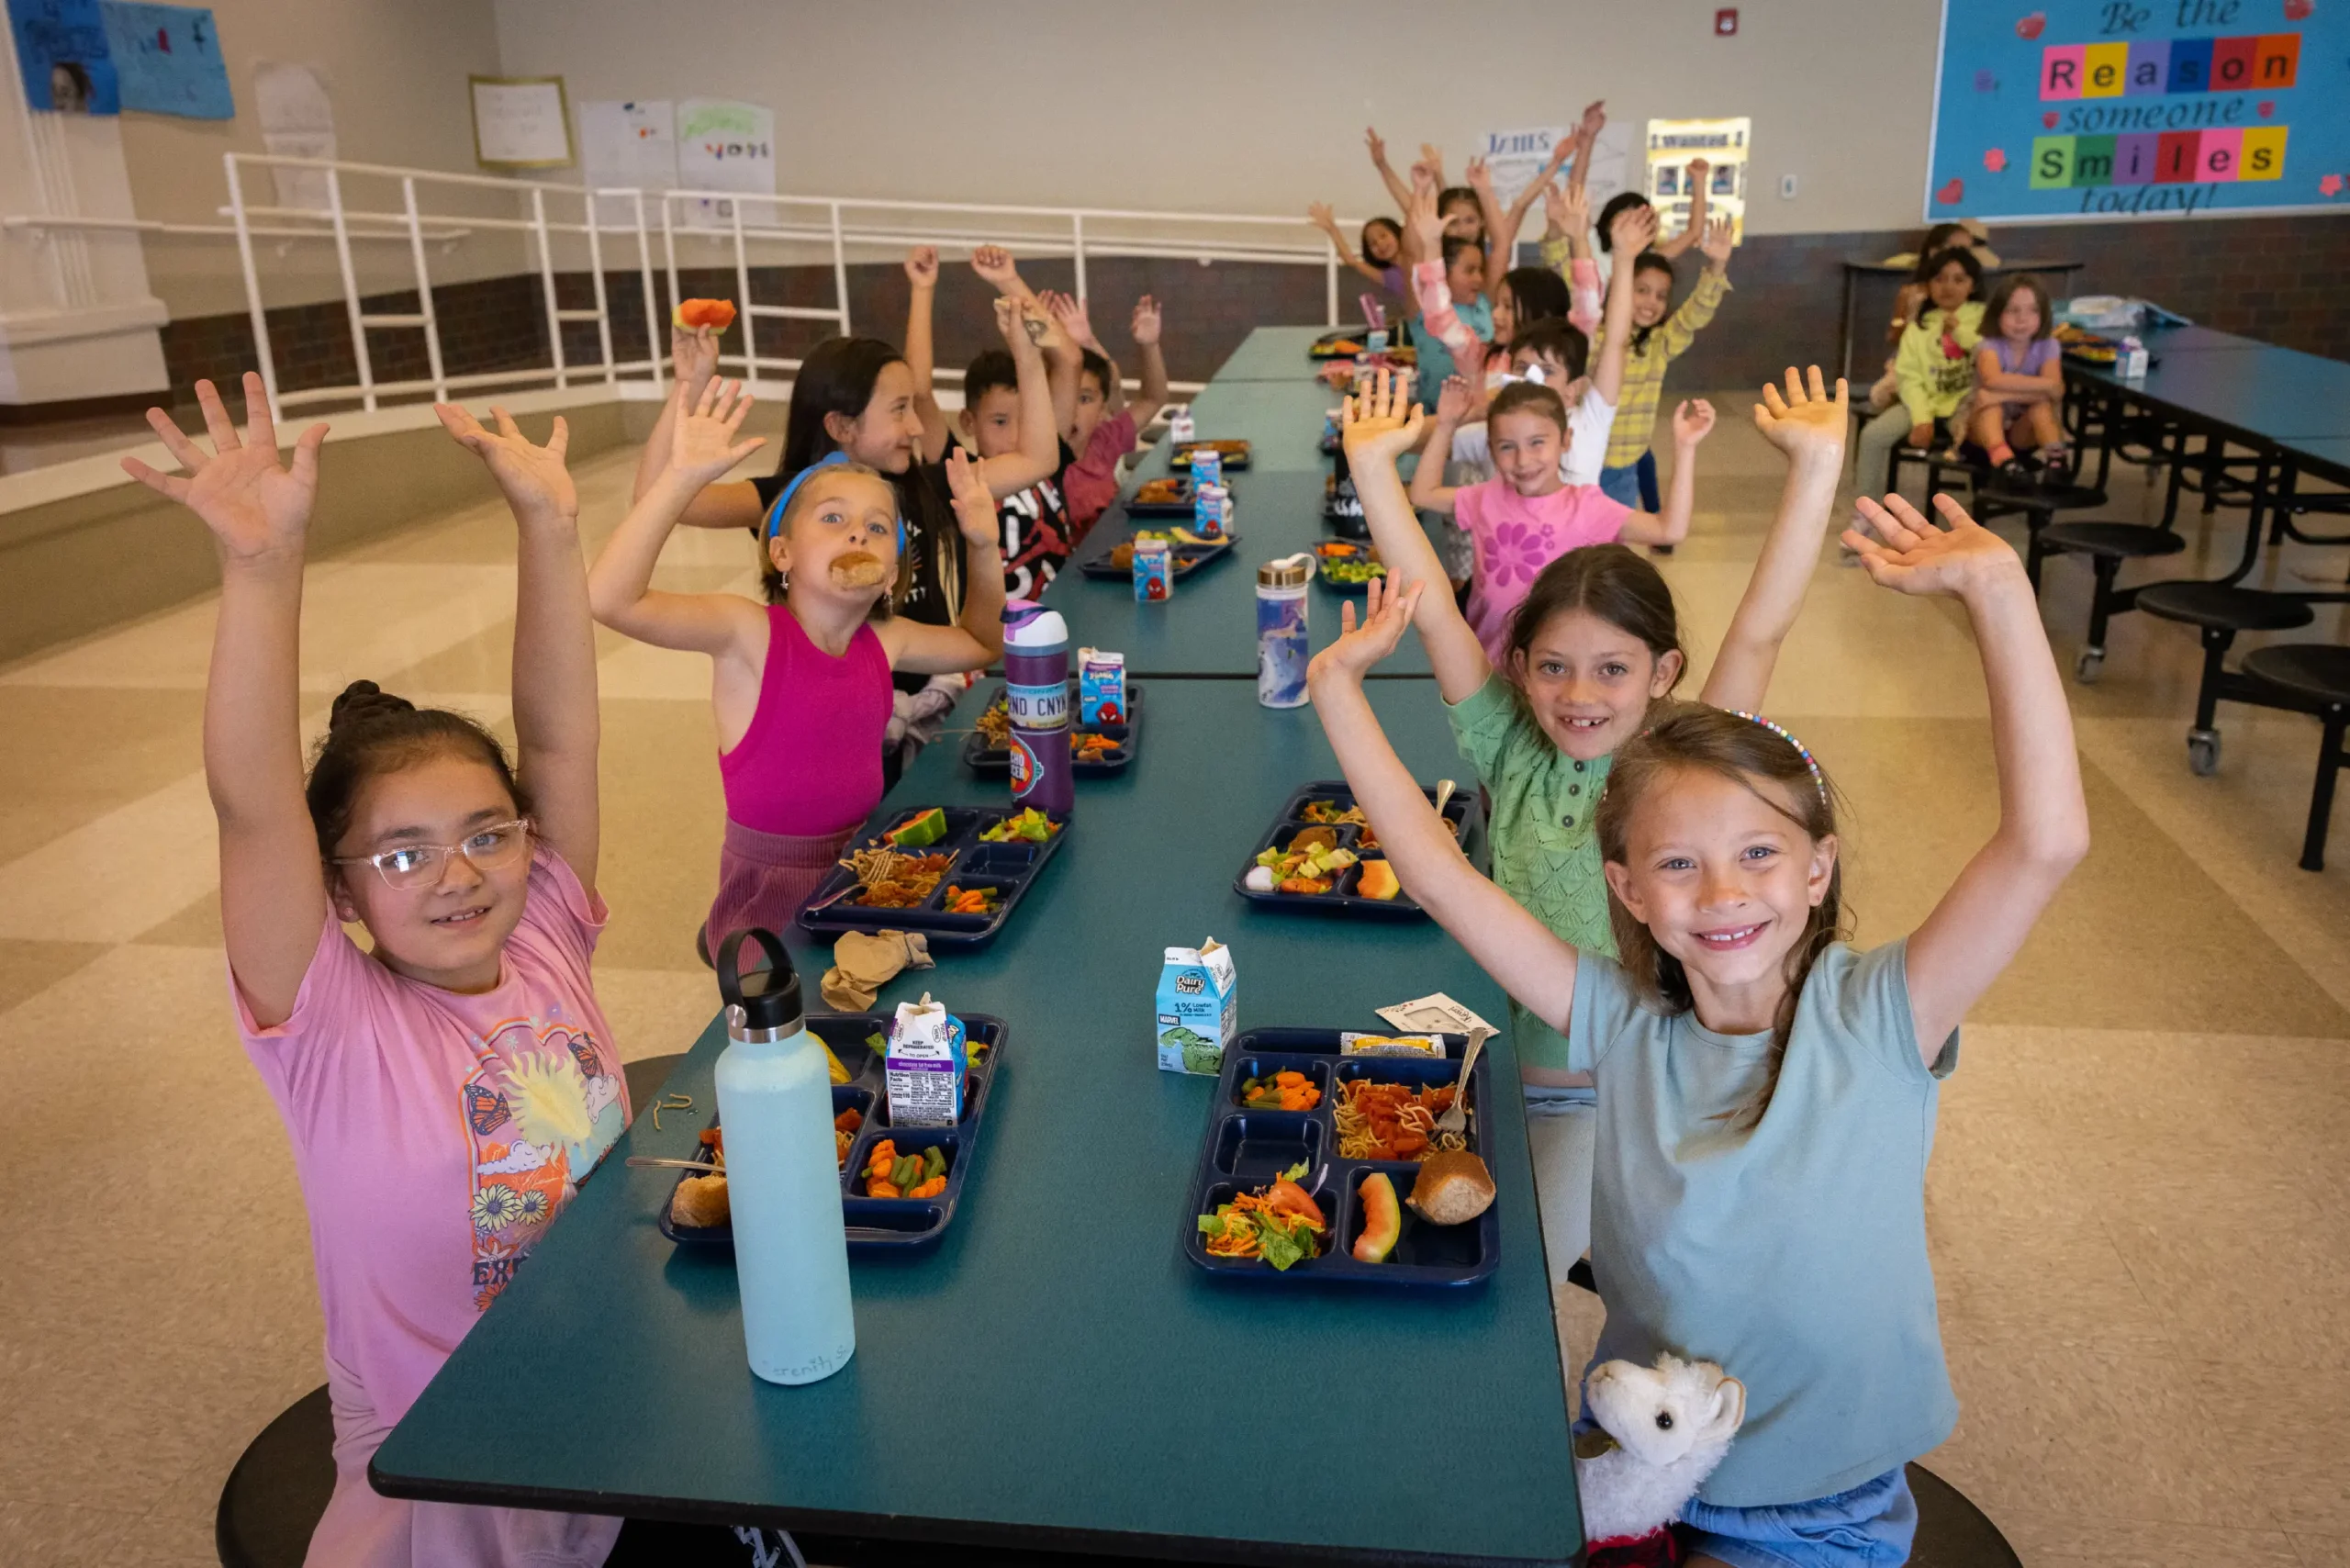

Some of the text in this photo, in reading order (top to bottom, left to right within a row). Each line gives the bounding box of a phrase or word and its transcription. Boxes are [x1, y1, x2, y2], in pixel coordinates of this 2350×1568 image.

[2100, 0, 2240, 35] Be the
[2049, 55, 2288, 90] Reason
[2065, 97, 2244, 132] someone
[2040, 145, 2273, 179] Smiles
[2080, 183, 2218, 215] today!
[1177, 976, 1205, 989] Dairy
[1177, 984, 1201, 994] Pure
[1159, 1015, 1180, 1025] MARVEL
[1174, 1002, 1192, 1013] 1%
